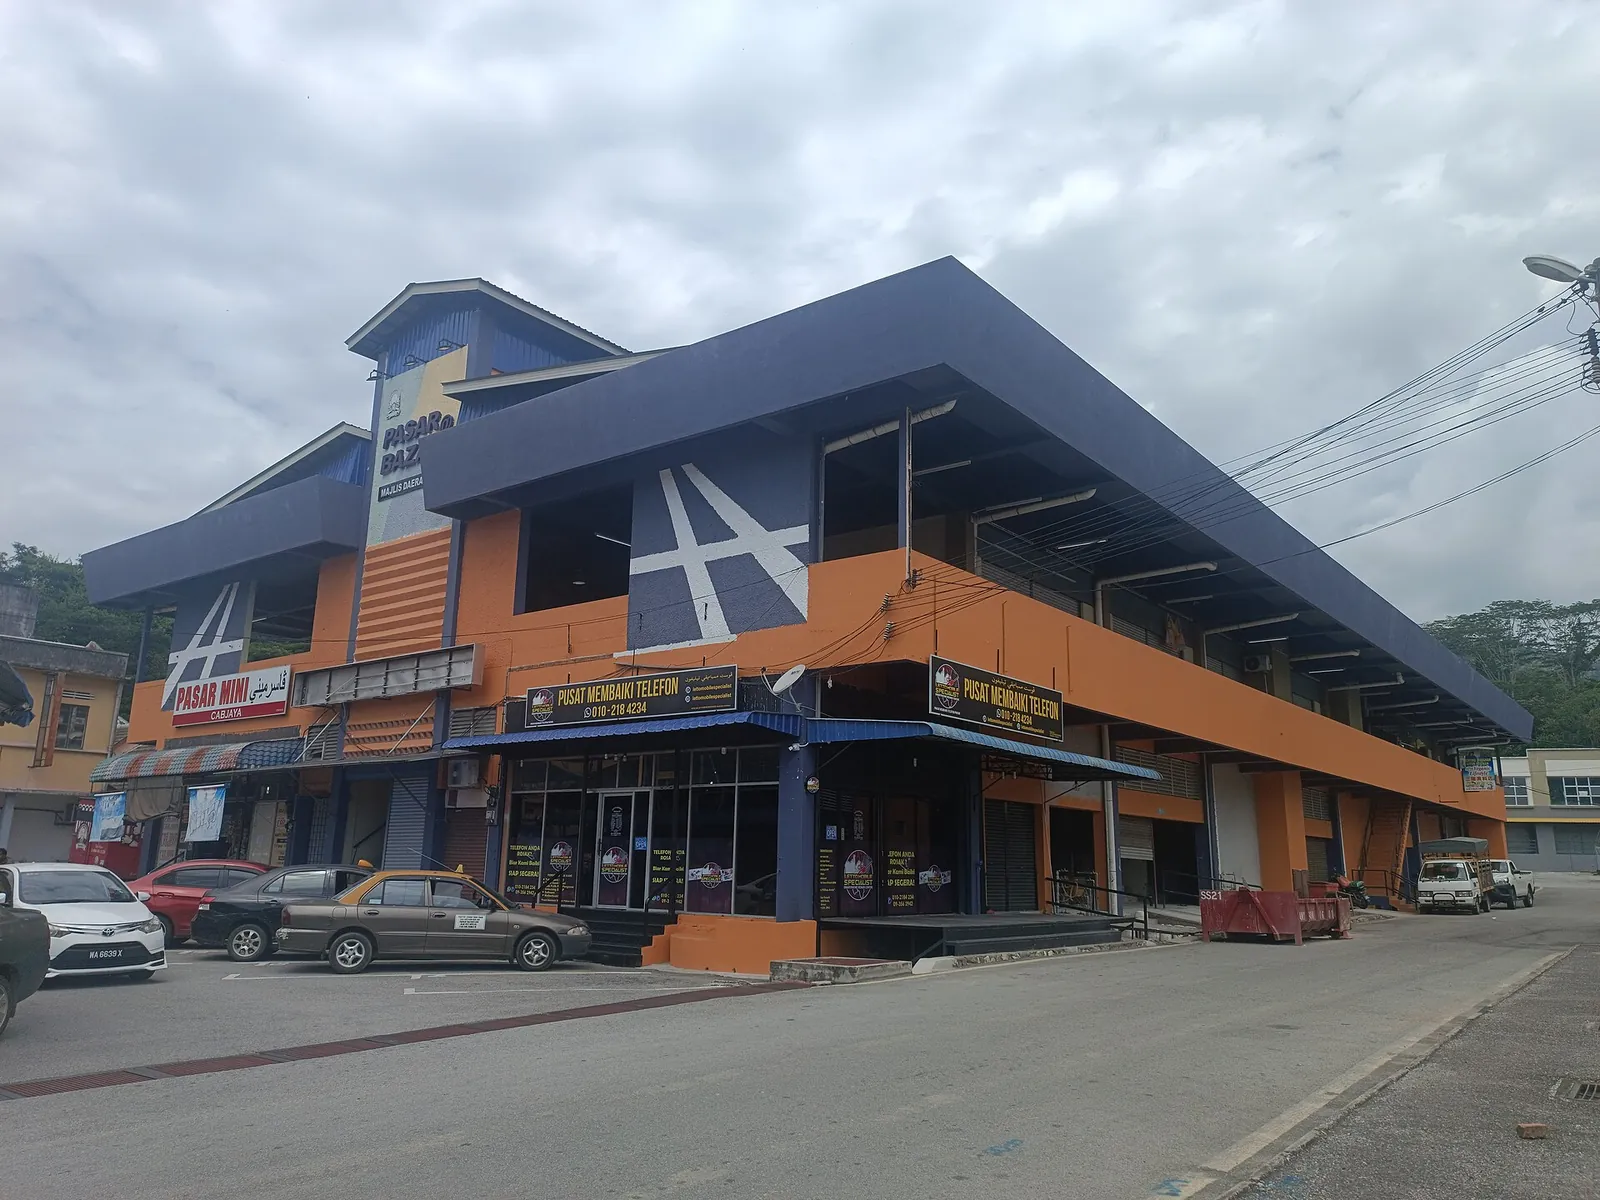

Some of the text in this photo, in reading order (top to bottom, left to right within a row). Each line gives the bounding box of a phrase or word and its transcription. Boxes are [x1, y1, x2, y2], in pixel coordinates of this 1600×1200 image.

[380, 444, 421, 476] BAZ
[381, 483, 402, 498] MAJLIS
[176, 676, 250, 711] PASAR MINI
[558, 677, 679, 706] PUSAT MEMBAIKI TELEFON
[964, 677, 1060, 721] PUSAT MEMBAIKI TELEFON
[210, 708, 242, 720] CABJAYA
[592, 702, 647, 718] 010-218 4234
[1200, 890, 1223, 900] SS21
[89, 951, 98, 959] WA
[117, 949, 123, 957] X
